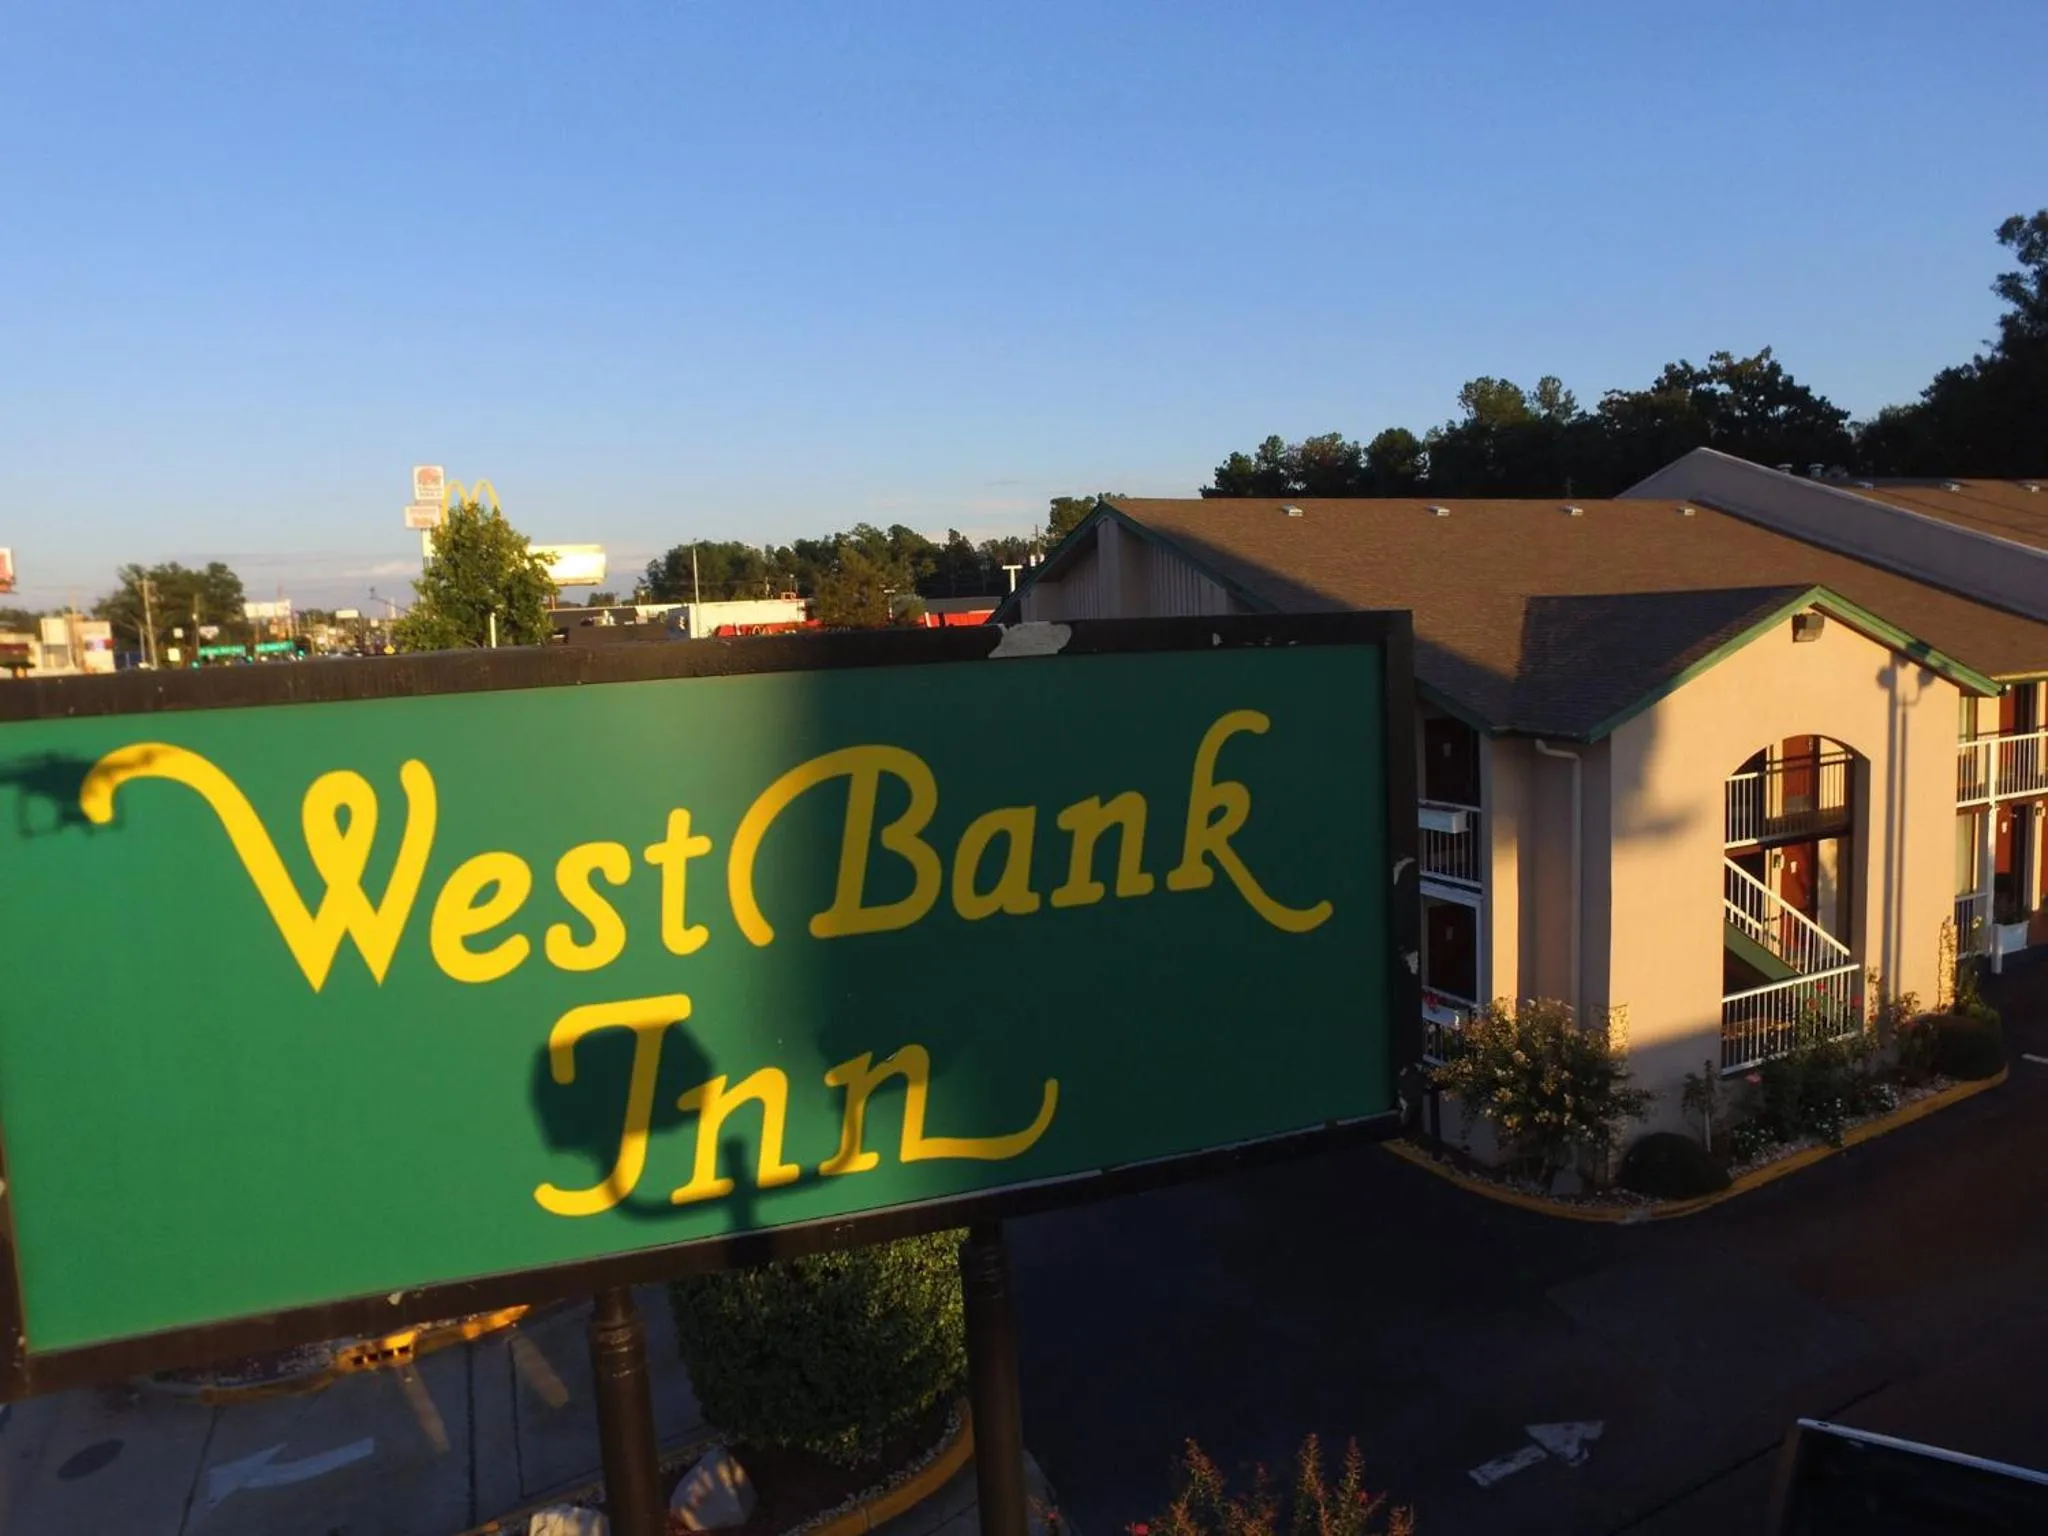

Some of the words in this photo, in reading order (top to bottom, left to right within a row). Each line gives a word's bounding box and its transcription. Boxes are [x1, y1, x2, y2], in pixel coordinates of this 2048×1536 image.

[80, 742, 712, 991] West
[726, 710, 1333, 948] Bank
[534, 993, 1057, 1217] Inn
